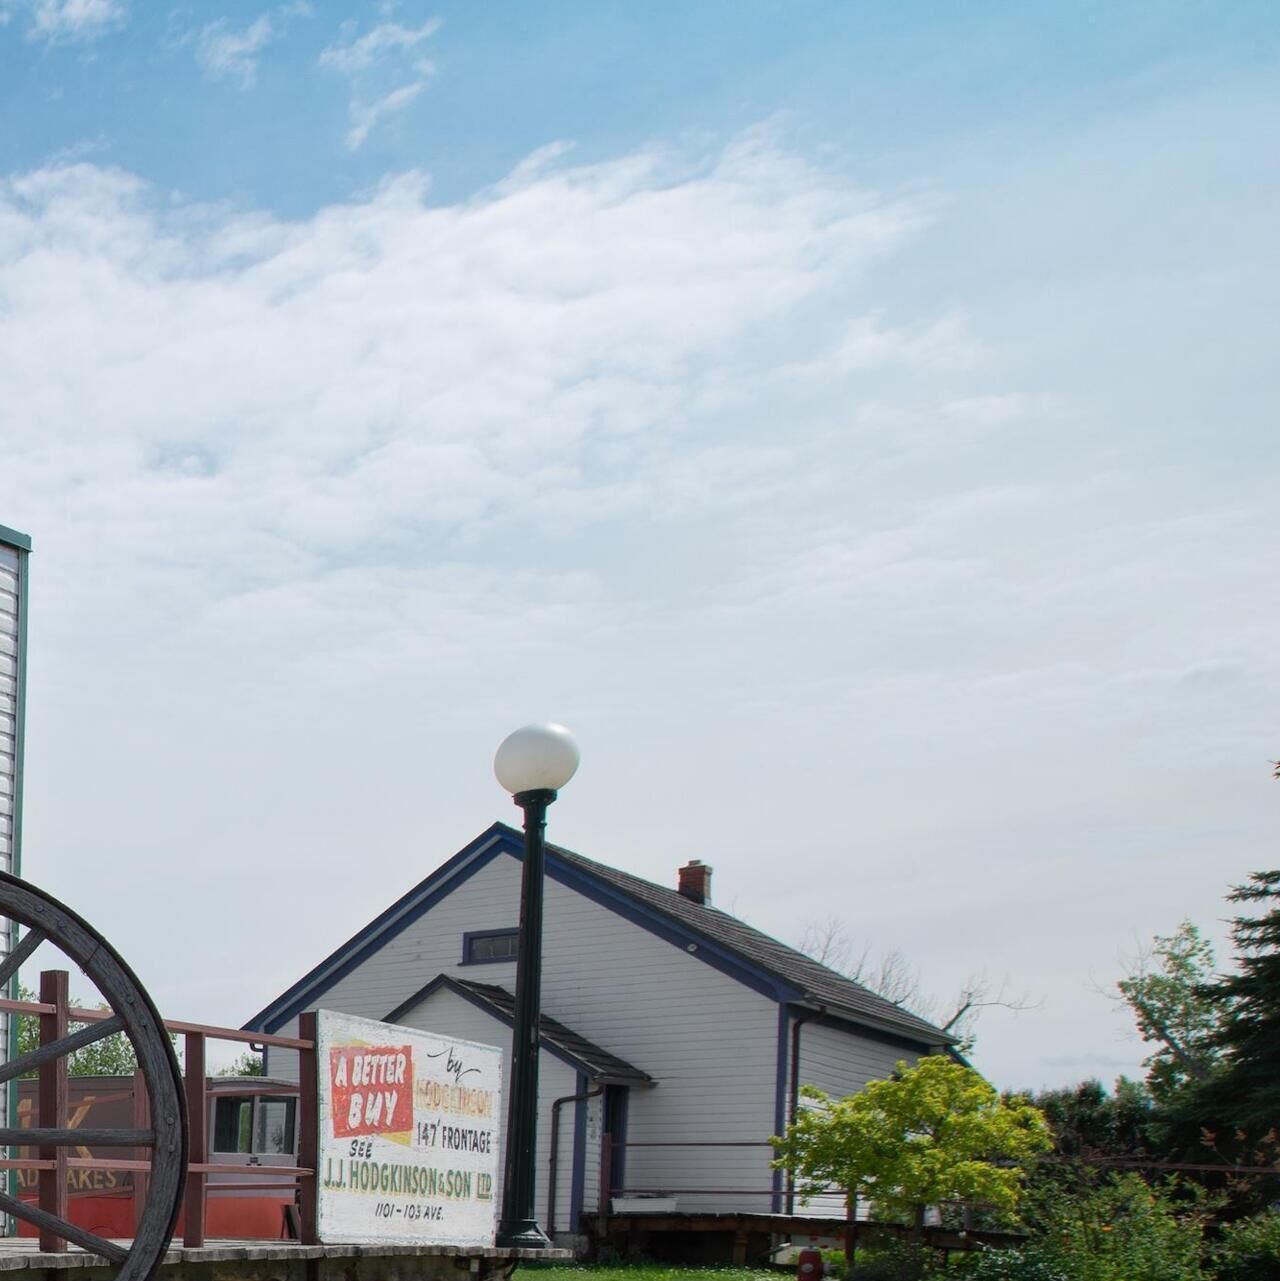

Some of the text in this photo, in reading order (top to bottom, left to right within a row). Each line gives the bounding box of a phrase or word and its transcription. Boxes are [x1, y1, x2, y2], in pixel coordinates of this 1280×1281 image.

[335, 1053, 407, 1087] A BETTER
[348, 1090, 398, 1130] BUY
[349, 1139, 373, 1159] SEE
[442, 1126, 491, 1154] FRONTAGE
[66, 1168, 116, 1190] AKES
[350, 1160, 437, 1196] HODGKINSON
